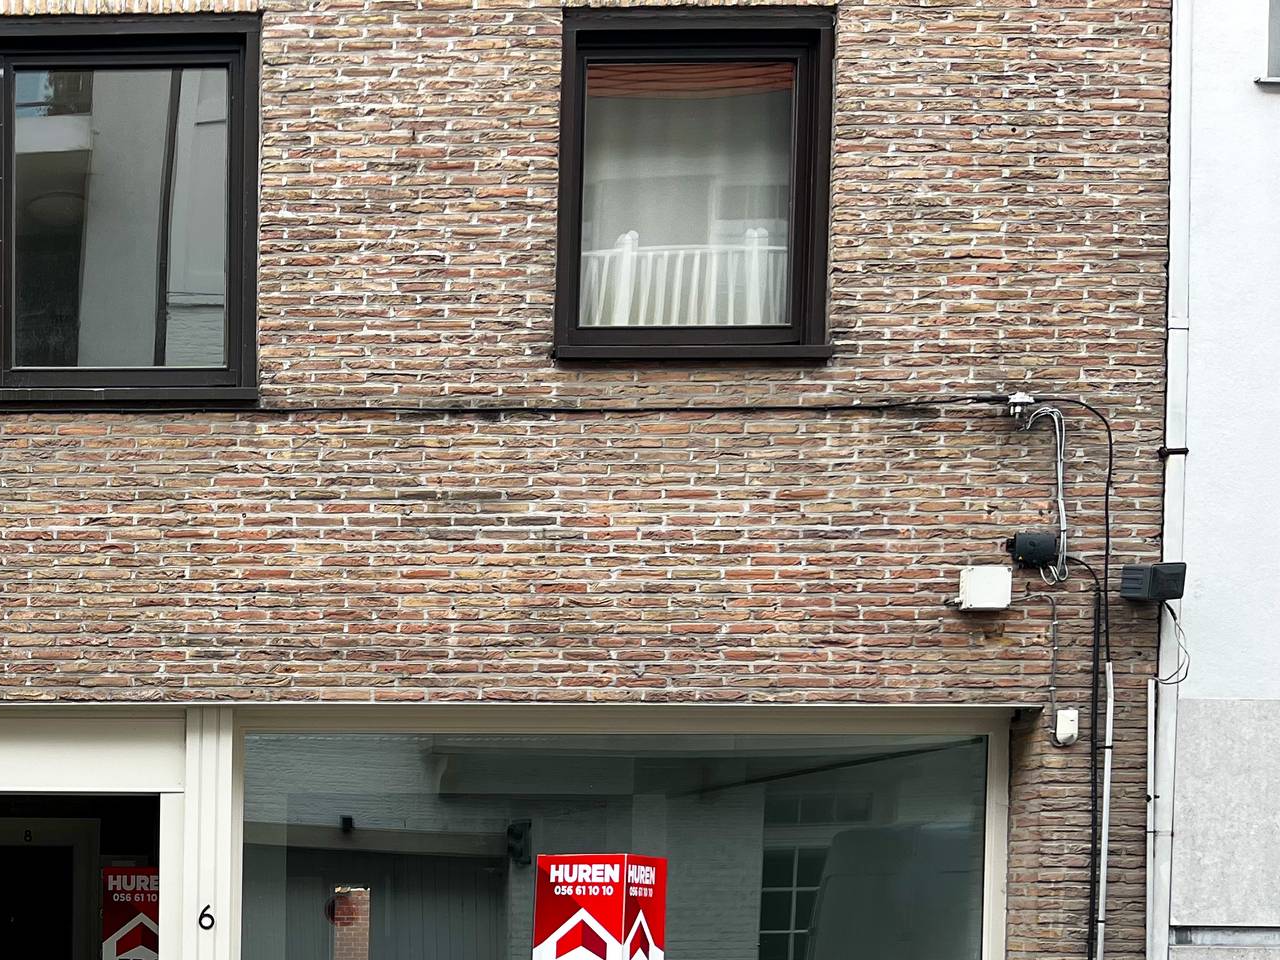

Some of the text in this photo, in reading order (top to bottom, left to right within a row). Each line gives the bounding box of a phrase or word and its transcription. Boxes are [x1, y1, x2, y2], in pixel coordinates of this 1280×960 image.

[24, 830, 32, 842] 8
[549, 863, 620, 883] HUREN
[628, 864, 656, 886] HUREN
[107, 875, 159, 891] HURE
[554, 885, 614, 896] 056 61 10 10
[113, 893, 158, 902] 056 61 10
[198, 904, 215, 930] 6
